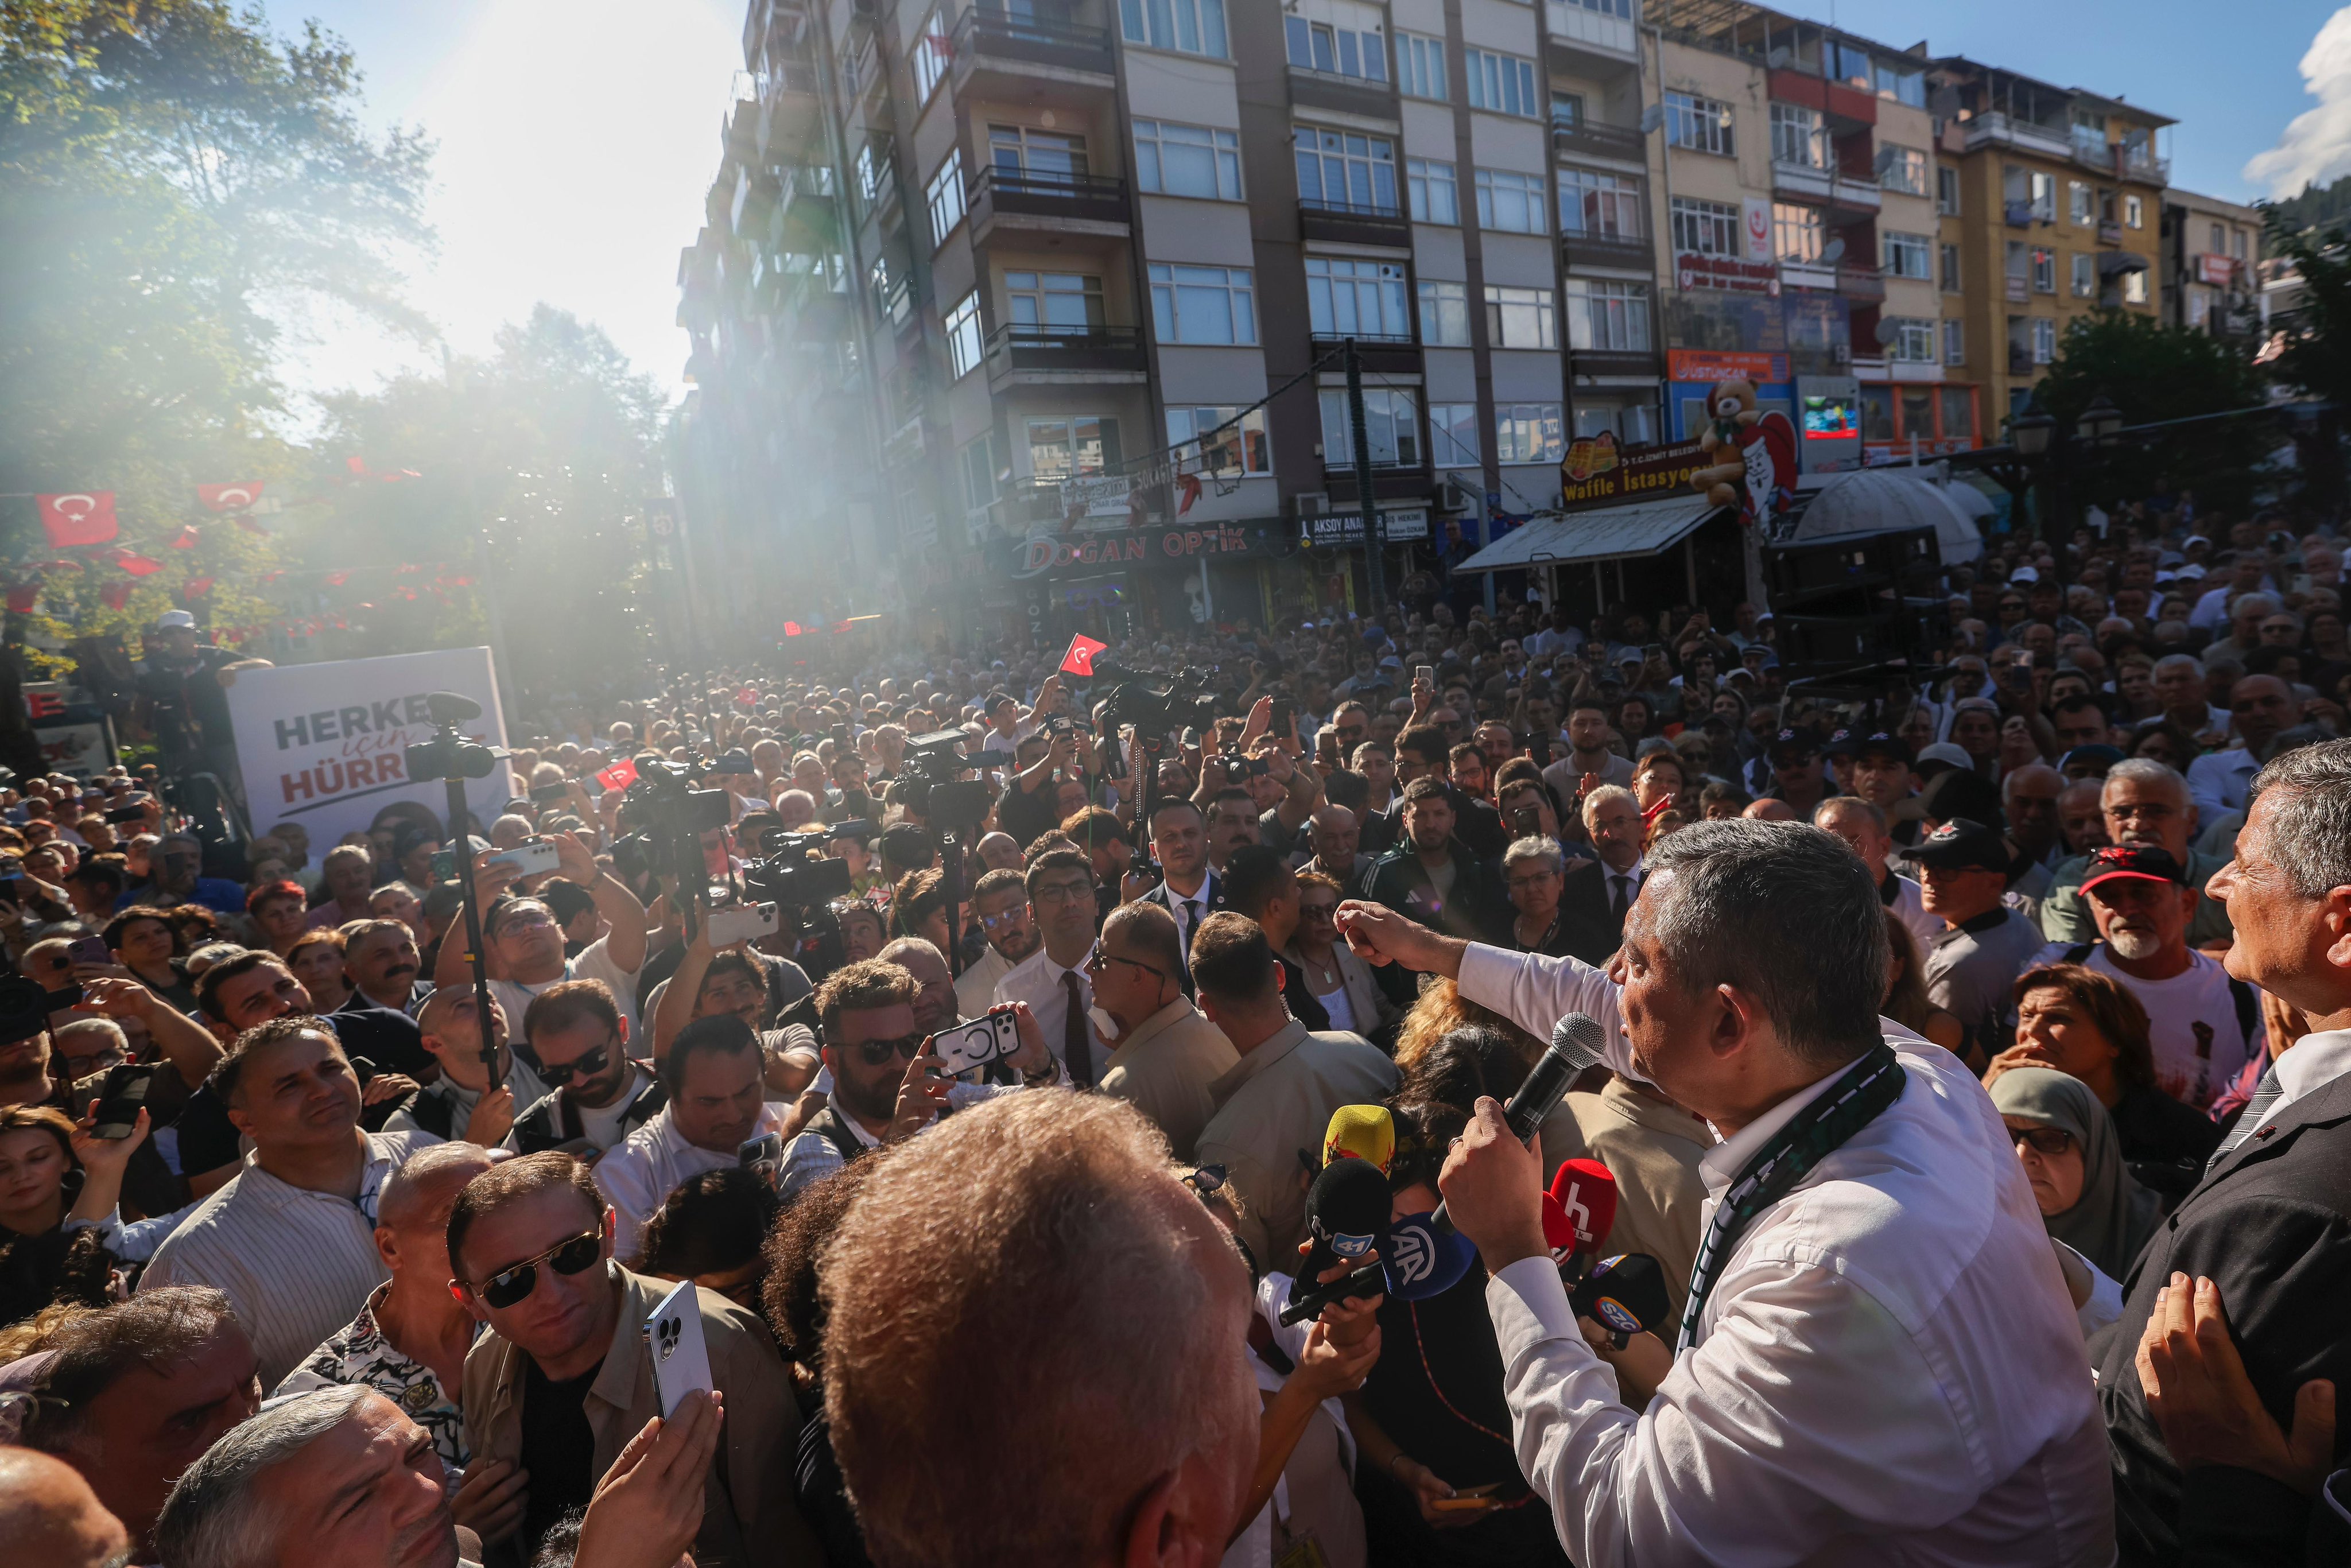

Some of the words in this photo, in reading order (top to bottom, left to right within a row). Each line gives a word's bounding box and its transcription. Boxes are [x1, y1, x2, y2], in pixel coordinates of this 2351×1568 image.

[1564, 478, 1615, 501] Waffle
[1314, 518, 1342, 533] AKSOY
[1344, 514, 1383, 531] ANAR
[1407, 525, 1426, 533] ÖZKAN
[1012, 532, 1147, 579] DOĞAN
[1163, 523, 1248, 557] OPTİK
[274, 693, 429, 750] HERKE
[342, 728, 417, 759] için
[1337, 1240, 1366, 1253] 41
[1390, 1234, 1425, 1286] AA
[1602, 1303, 1636, 1330] SZC
